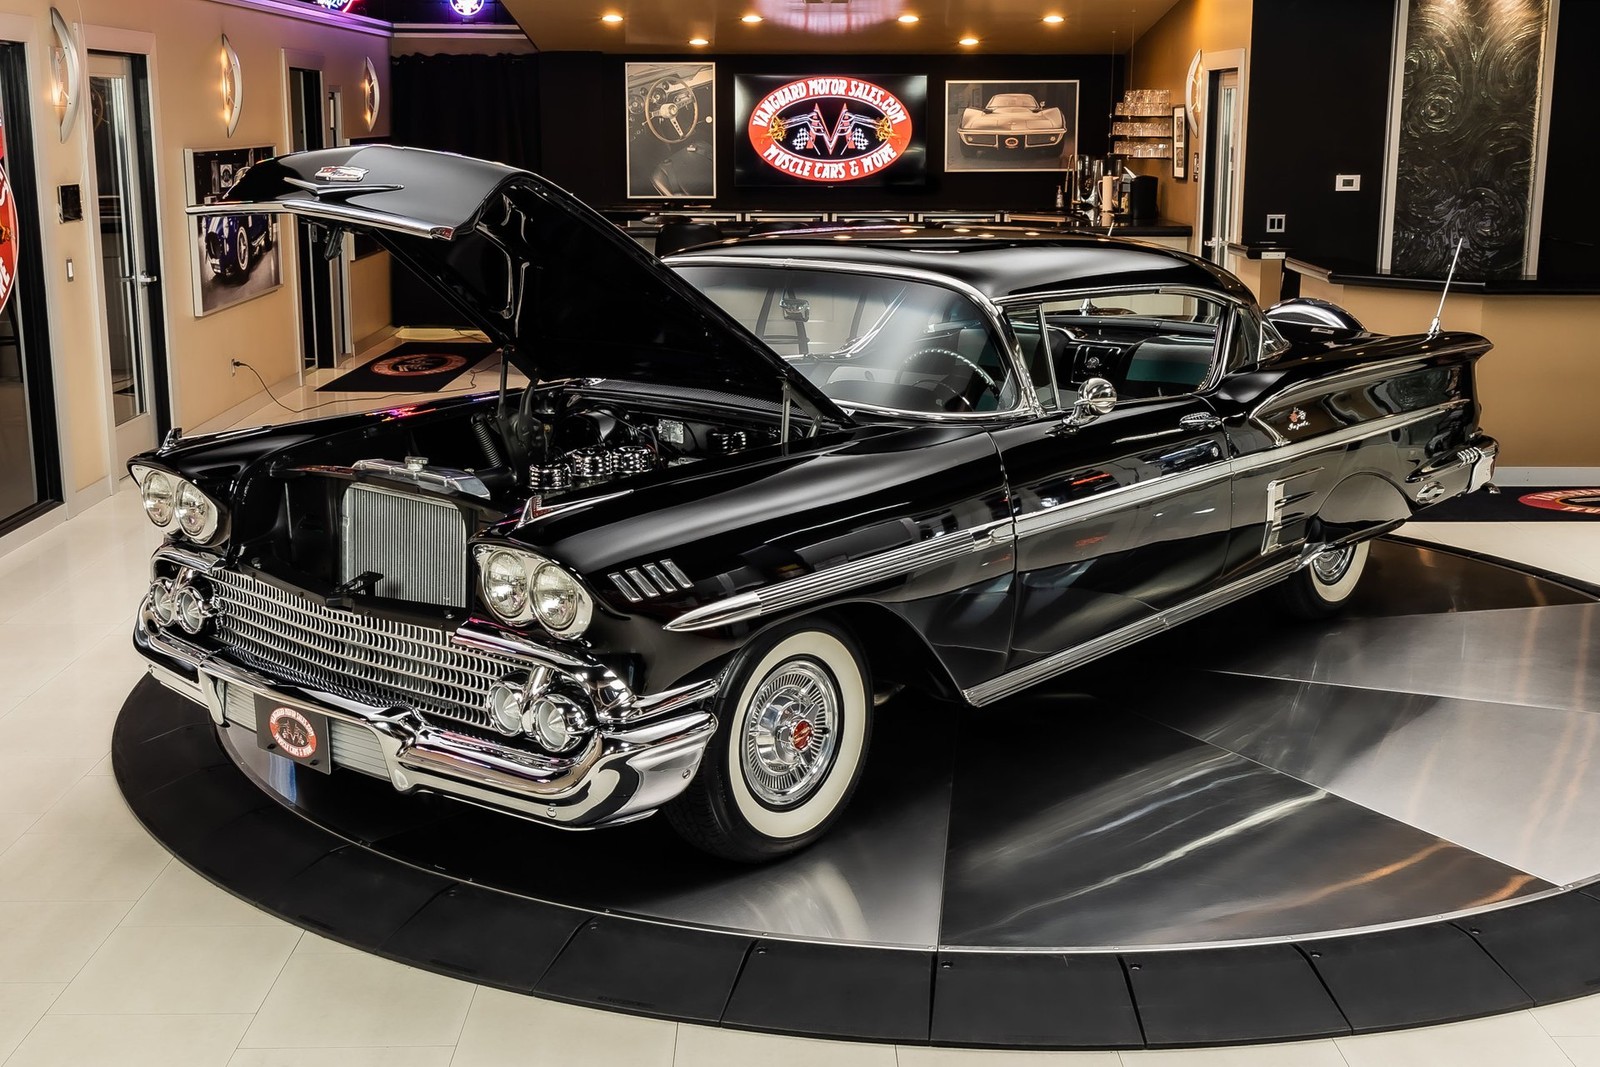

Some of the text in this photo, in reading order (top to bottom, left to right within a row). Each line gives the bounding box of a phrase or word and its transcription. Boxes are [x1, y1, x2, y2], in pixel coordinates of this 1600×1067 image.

[752, 78, 907, 128] VANGUARD MOTOR SALES.COM
[763, 143, 897, 179] MUSCLE CARS & MORE
